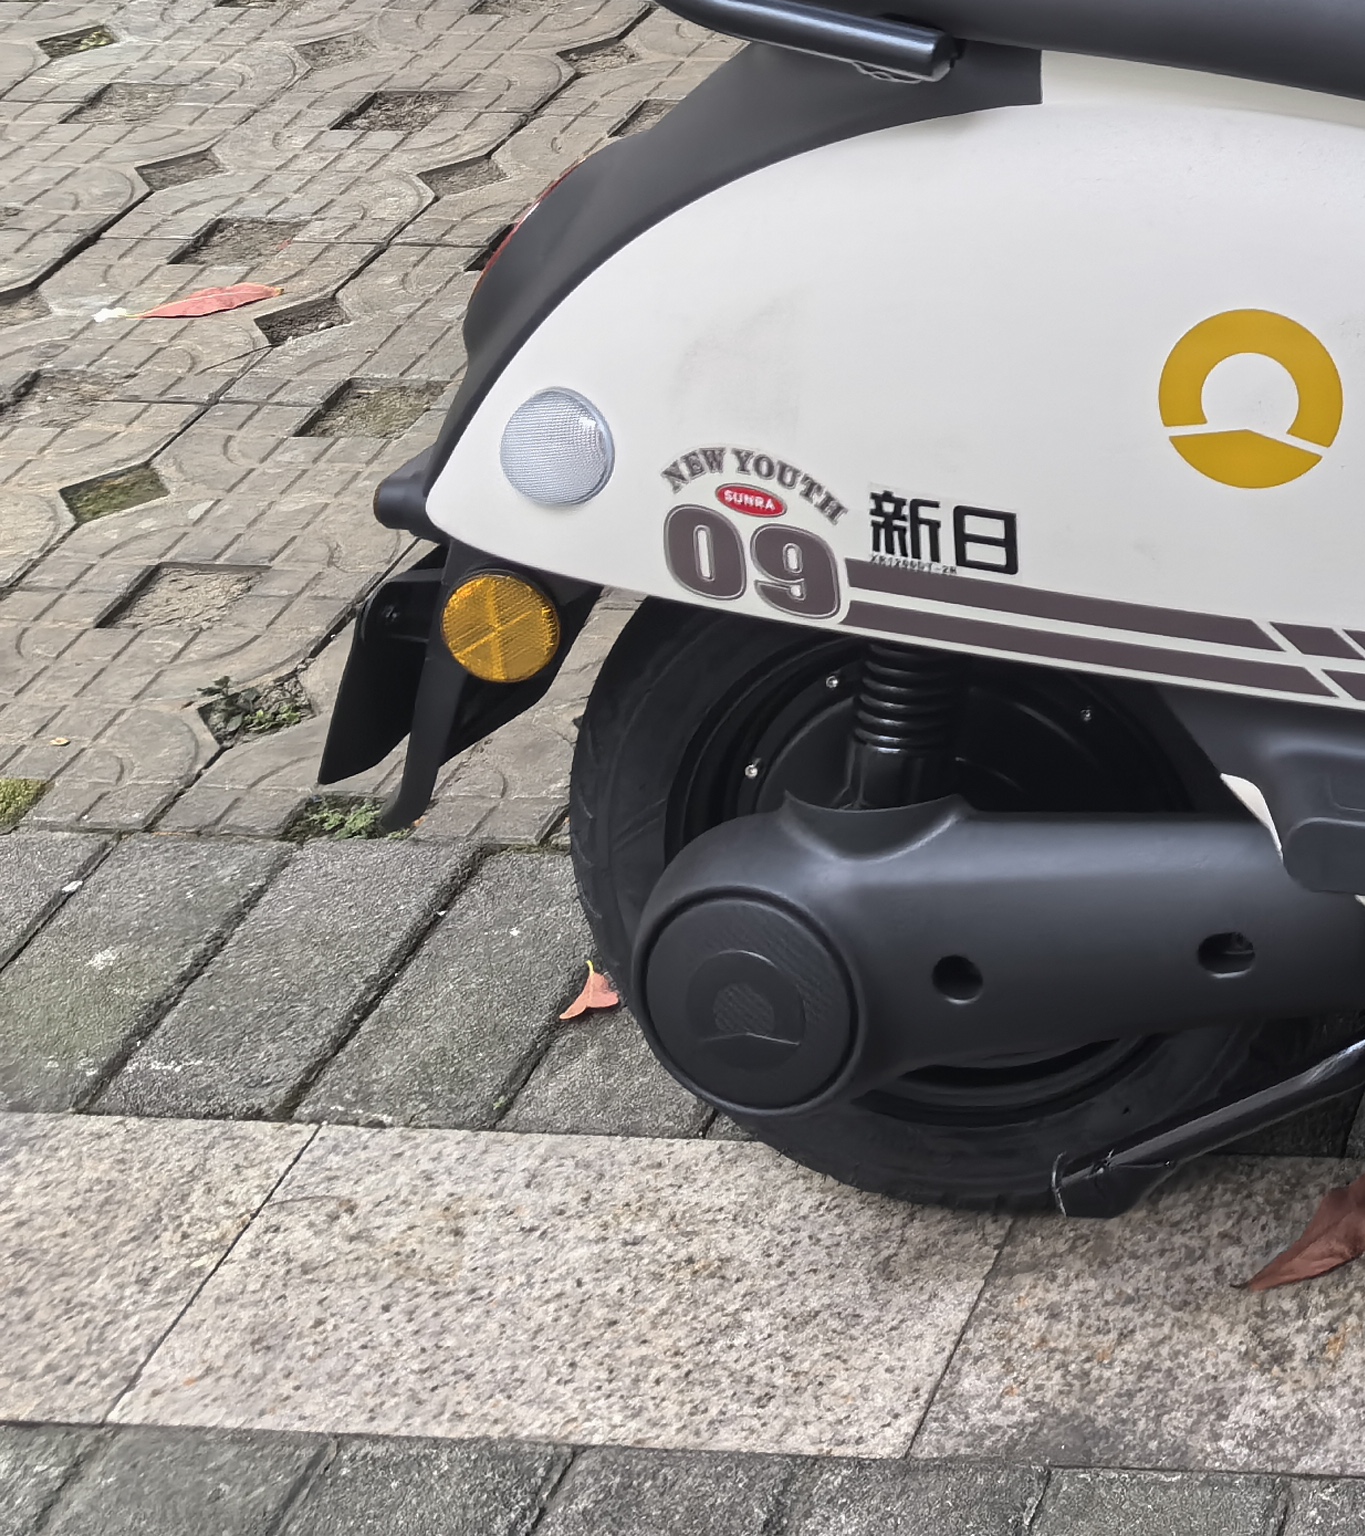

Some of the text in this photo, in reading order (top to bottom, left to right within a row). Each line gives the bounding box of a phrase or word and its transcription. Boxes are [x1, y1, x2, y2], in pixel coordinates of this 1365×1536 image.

[660, 447, 849, 526] NEW YOUTH
[723, 489, 776, 511] SUNRA
[663, 503, 841, 620] 09
[869, 490, 1019, 576] 新日
